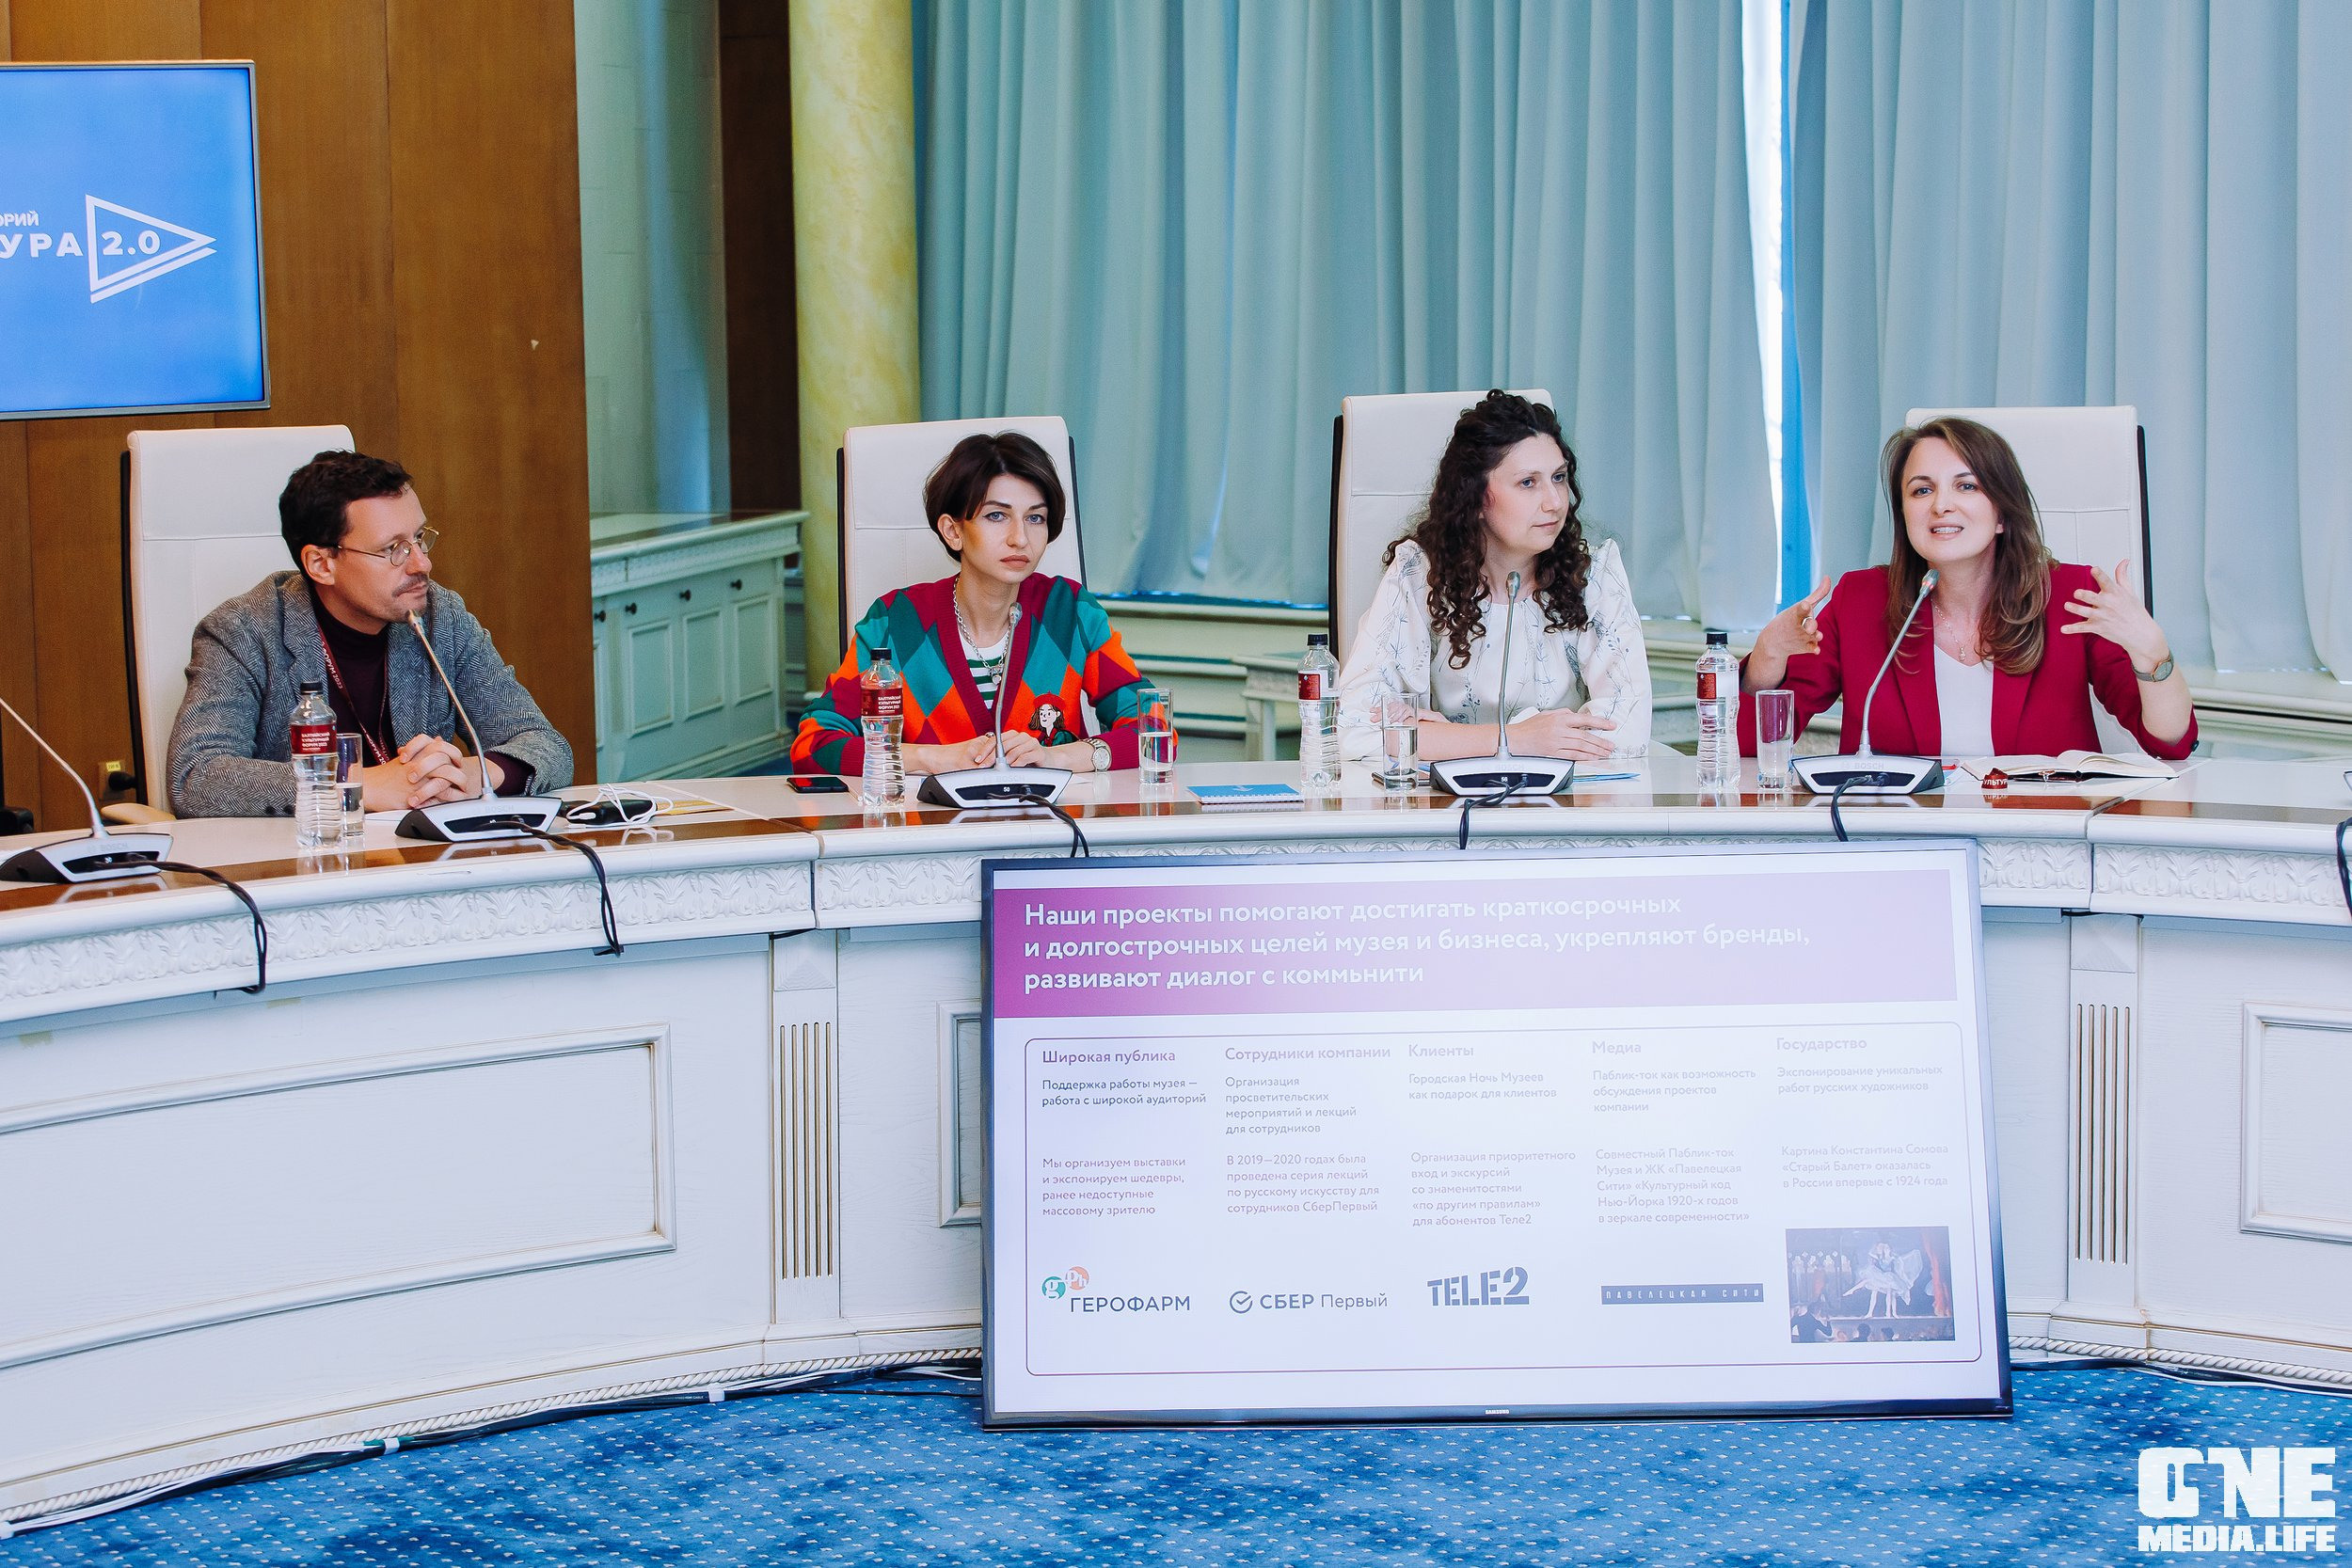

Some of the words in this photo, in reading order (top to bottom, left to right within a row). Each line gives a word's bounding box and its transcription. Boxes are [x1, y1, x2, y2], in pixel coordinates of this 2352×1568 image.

[0, 232, 84, 259] УРА
[102, 230, 161, 256] 2.0
[1854, 762, 1884, 770] BOSCH
[998, 774, 1025, 783] BOSCH
[101, 843, 128, 852] BOSCH
[1025, 903, 1095, 926] Наши
[1104, 908, 1212, 929] проекты
[1219, 905, 1343, 922] помогают
[1349, 903, 1475, 922] достигать
[1483, 898, 1681, 922] краткосрочных
[1025, 942, 1039, 957] и
[1045, 939, 1244, 960] долгострочных
[1251, 931, 1327, 956] целей
[1335, 936, 1408, 957] музея
[1416, 935, 1431, 950] и
[1438, 928, 1549, 951] бизнеса,
[1554, 930, 1696, 953] укрепляют
[1703, 923, 1809, 949] бренды,
[1025, 972, 1161, 995] развивают
[1167, 970, 1256, 990] диалог
[1262, 970, 1275, 985] с
[1408, 1043, 1473, 1057] Клиенты
[1592, 1040, 1641, 1055] Медиа
[1776, 1037, 1867, 1053] Государство
[1042, 1050, 1110, 1066] Широкая
[1115, 1049, 1175, 1066] публика
[1225, 1047, 1313, 1063] Сотрудники
[1318, 1048, 1391, 1059] компании
[1408, 1073, 1466, 1086] Городская
[1469, 1072, 1498, 1083] Ночь
[1501, 1071, 1544, 1085] Музеев
[1593, 1069, 1658, 1081] Паблик-ток
[1661, 1071, 1679, 1080] как
[1681, 1070, 1756, 1080] возможность
[1776, 1067, 1873, 1079] Экспонирование
[1875, 1067, 1943, 1078] уникальных
[1042, 1079, 1106, 1091] Поддержка
[1109, 1078, 1150, 1091] работы
[1152, 1080, 1185, 1091] музея
[1225, 1076, 1299, 1089] Организация
[1777, 1082, 1810, 1095] работ
[1813, 1084, 1858, 1095] русских
[1860, 1083, 1929, 1094] художников
[1225, 1093, 1329, 1104] просветительских
[1408, 1091, 1427, 1100] как
[1430, 1090, 1478, 1102] подарок
[1481, 1090, 1501, 1100] для
[1503, 1089, 1557, 1098] клиентов
[1593, 1085, 1661, 1099] обсуждения
[1664, 1086, 1717, 1098] проектов
[1041, 1095, 1080, 1108] работа
[1092, 1094, 1143, 1106] широкой
[1226, 1107, 1302, 1120] мероприятий
[1314, 1106, 1357, 1117] лекций
[1594, 1103, 1648, 1113] компании
[1225, 1126, 1246, 1135] для
[1248, 1125, 1321, 1136] сотрудников
[1596, 1148, 1665, 1160] Совместный
[1668, 1148, 1735, 1159] Паблик-ток
[1781, 1146, 1828, 1158] Картина
[1831, 1145, 1903, 1156] Константина
[1905, 1143, 1948, 1154] Сомова
[1042, 1158, 1061, 1168] Мы
[1064, 1160, 1131, 1170] организуем
[1134, 1159, 1185, 1167] выставки
[1227, 1155, 1234, 1165] В
[1304, 1156, 1335, 1165] годах
[1337, 1153, 1366, 1164] была
[1410, 1151, 1486, 1164] Организация
[1488, 1152, 1576, 1164] приоритетного
[1411, 1170, 1438, 1180] вход
[1451, 1166, 1510, 1180] экскурсий
[1597, 1164, 1632, 1178] Музея
[1645, 1164, 1665, 1174] ЖК
[1782, 1161, 1830, 1174] «Старый
[1834, 1160, 1872, 1171] Балет»
[1874, 1162, 1931, 1171] оказалась
[1052, 1176, 1127, 1186] экспонируем
[1130, 1175, 1184, 1184] шедевры,
[1227, 1173, 1287, 1183] проведена
[1290, 1172, 1324, 1182] серия
[1327, 1169, 1368, 1180] лекций
[1792, 1177, 1833, 1188] России
[1836, 1179, 1883, 1189] впервые
[1896, 1175, 1920, 1186] 1924
[1923, 1178, 1948, 1187] года
[1227, 1189, 1241, 1197] по
[1244, 1188, 1297, 1199] русскому
[1300, 1187, 1357, 1198] искусству
[1359, 1187, 1379, 1196] для
[1411, 1186, 1425, 1195] со
[1427, 1185, 1521, 1195] знаменитостями
[1597, 1180, 1631, 1192] Сити»
[1635, 1180, 1708, 1193] «Культурный
[1710, 1181, 1731, 1190] код
[1042, 1192, 1075, 1202] ранее
[1078, 1191, 1153, 1201] недоступные
[1597, 1194, 1664, 1209] Нью-Йорка
[1707, 1197, 1739, 1206] годов
[1042, 1208, 1104, 1218] массовому
[1106, 1207, 1155, 1217] зрителю
[1227, 1204, 1299, 1215] сотрудников
[1302, 1200, 1377, 1213] СберПервый
[1412, 1202, 1434, 1211] «по
[1436, 1202, 1476, 1212] другим
[1479, 1200, 1541, 1212] правилам»
[1412, 1218, 1433, 1227] для
[1436, 1215, 1496, 1226] абонентов
[1499, 1213, 1532, 1225] Теле2
[1598, 1215, 1605, 1224] в
[1607, 1214, 1652, 1226] зеркале
[1655, 1213, 1749, 1224] современности»
[1427, 1266, 1530, 1307] TELE2
[1259, 1293, 1314, 1309] СБЕР
[1321, 1291, 1389, 1310] Первый
[1606, 1290, 1707, 1300] ПАВЕЛЕЦКАЯ
[1722, 1289, 1759, 1298] СИТИ
[1071, 1295, 1191, 1313] ГЕРОФАРМ
